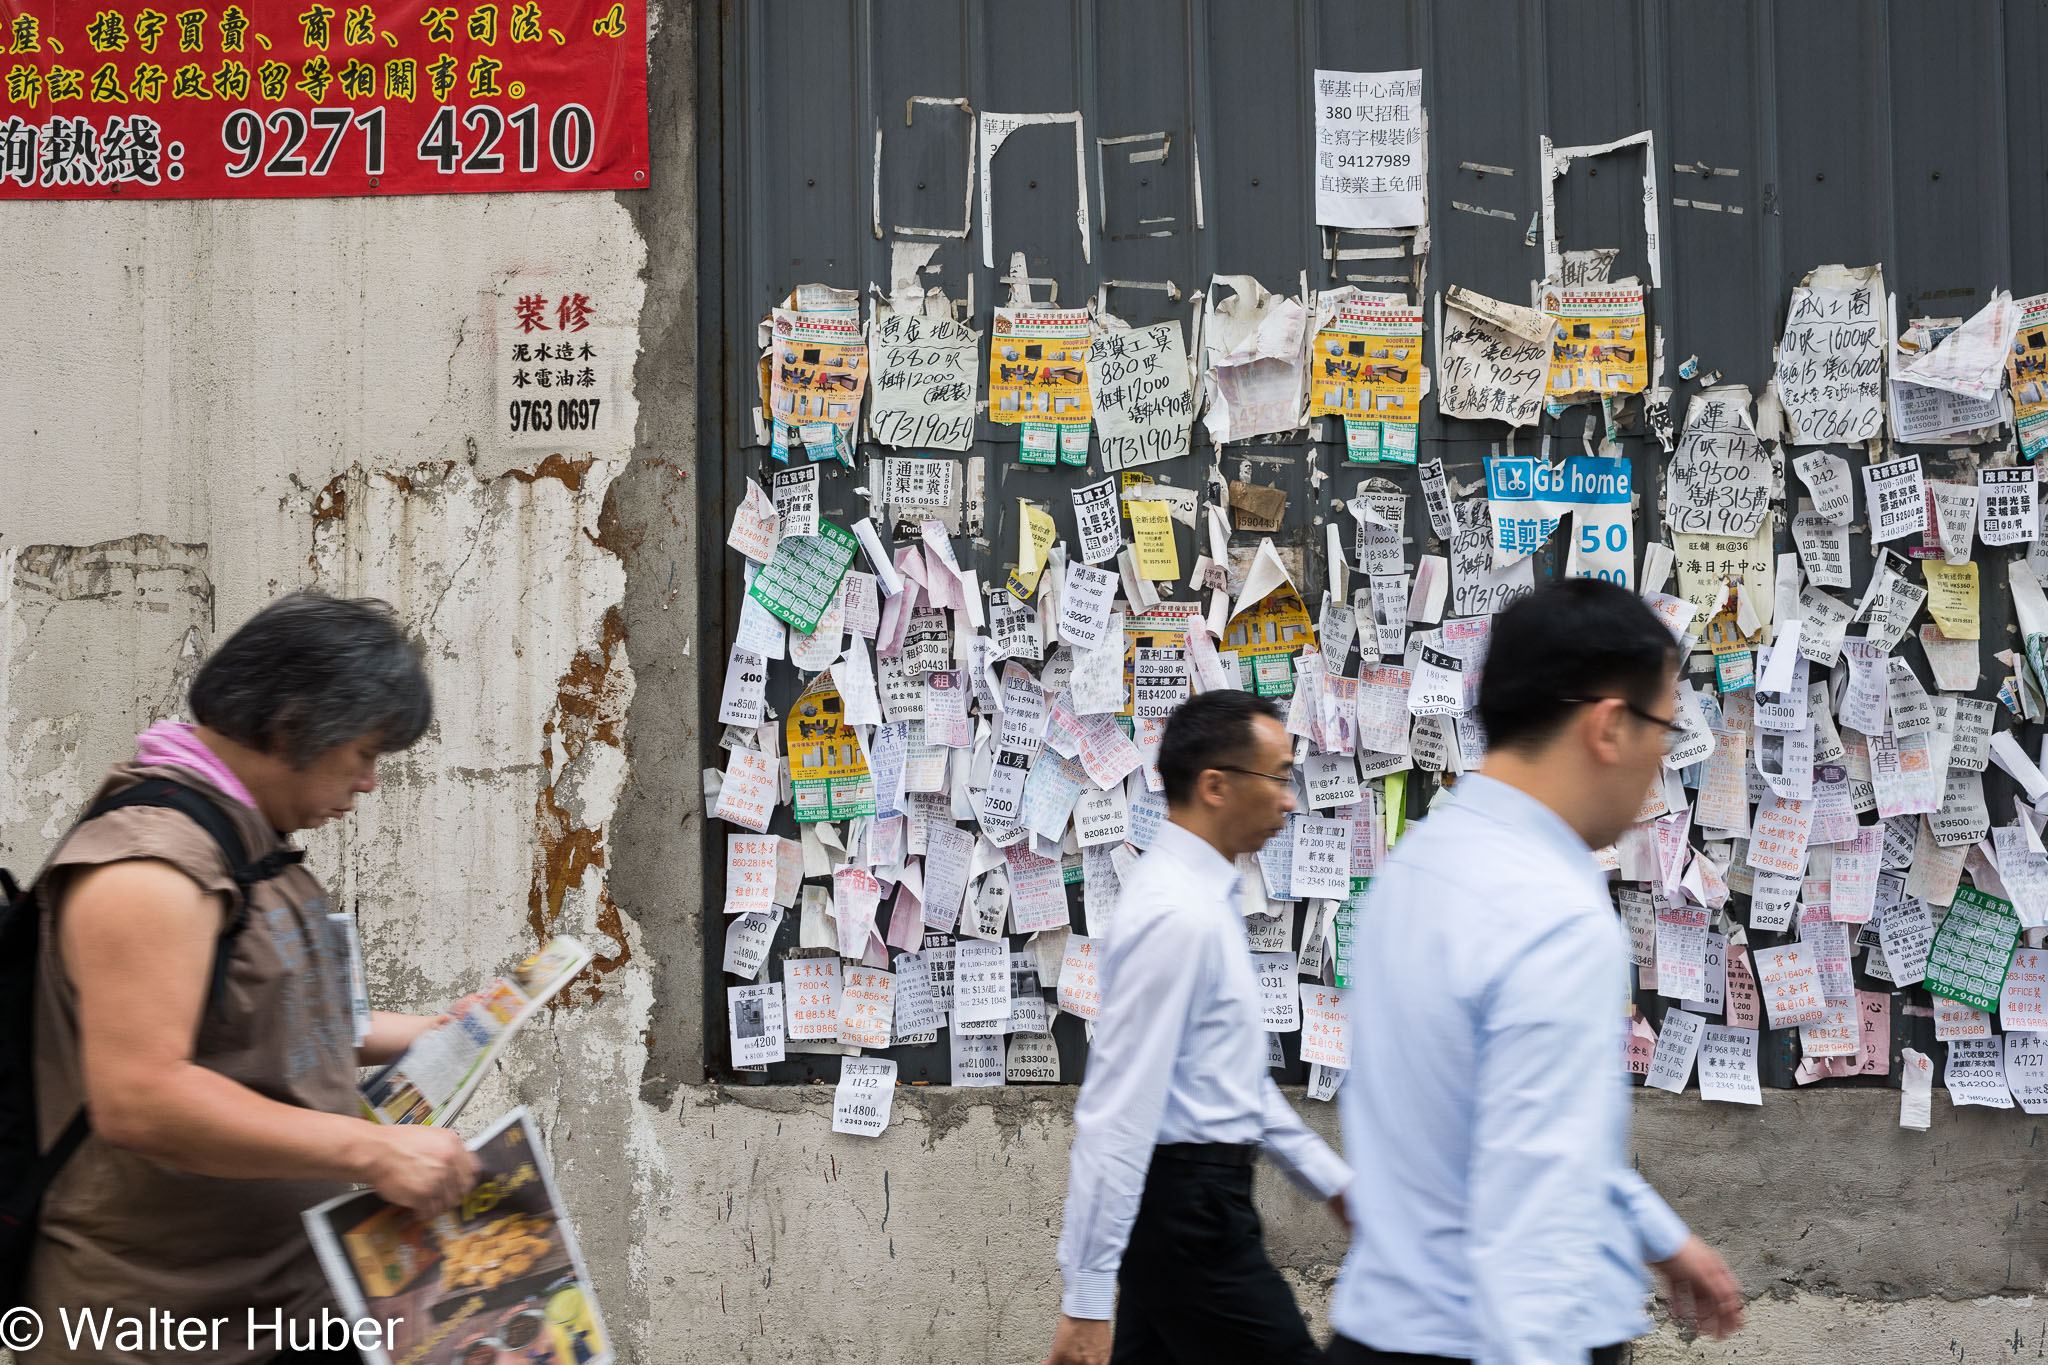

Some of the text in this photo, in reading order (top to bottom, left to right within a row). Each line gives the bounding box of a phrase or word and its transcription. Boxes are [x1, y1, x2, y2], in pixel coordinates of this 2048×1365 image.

[1319, 79, 1421, 98] 華基中心高層
[1326, 104, 1410, 122] 380 呎招租
[221, 106, 386, 178] 9271
[417, 102, 595, 175] 4210
[1319, 127, 1421, 146] 全寫字樓裝修
[1320, 151, 1410, 169] 電 94127989
[1320, 174, 1422, 194] 直接業主免佣
[514, 293, 597, 334] 裝修
[512, 341, 597, 362] 泥水造木
[512, 367, 596, 388] 水電油漆
[510, 398, 600, 431] 9763 0697
[895, 460, 911, 494] 通渠
[926, 463, 941, 495] 吸糞
[1534, 464, 1628, 495] GB home
[894, 496, 915, 504] 6155
[1944, 509, 1970, 518] 641 呎
[1987, 505, 2030, 517] 全城最平
[1881, 513, 1894, 527] 租
[1984, 519, 1999, 531] 租
[1581, 524, 1628, 553] 50
[756, 592, 807, 629] 2797-9400
[1062, 621, 1096, 641] 82082102
[1140, 665, 1173, 674] 320-980
[741, 672, 762, 682] 400
[1670, 744, 1707, 762] 82082102
[1365, 756, 1402, 771] 82082102
[1315, 790, 1354, 801] 82082102
[718, 808, 740, 821] 2763
[1084, 825, 1124, 838] 82082102
[1311, 839, 1323, 848] 200
[1326, 840, 1334, 850] 呎
[1337, 841, 1346, 850] 起
[1752, 853, 1799, 871] 2763 9869
[1309, 864, 1344, 876] $2,800 起
[1307, 877, 1345, 888] 2345 1048
[1756, 916, 1785, 925] 82082
[793, 963, 834, 976] 工業大廈
[972, 997, 1006, 1006] 2345 1048
[1931, 982, 1989, 1008] 2797-9400
[1776, 1011, 1822, 1026] 2763 9869
[2006, 1017, 2048, 1027] 2763 9869
[793, 1024, 838, 1034] 2763 9869
[1939, 1025, 1985, 1036] 2763 9869
[842, 1032, 862, 1042] 2763
[1714, 1045, 1728, 1054] 968
[1808, 1043, 1829, 1053] 2763
[2014, 1054, 2043, 1066] 4727
[845, 1064, 891, 1077] 宏光工廈
[1008, 1069, 1055, 1078] 37096170
[852, 1078, 878, 1089] 1142
